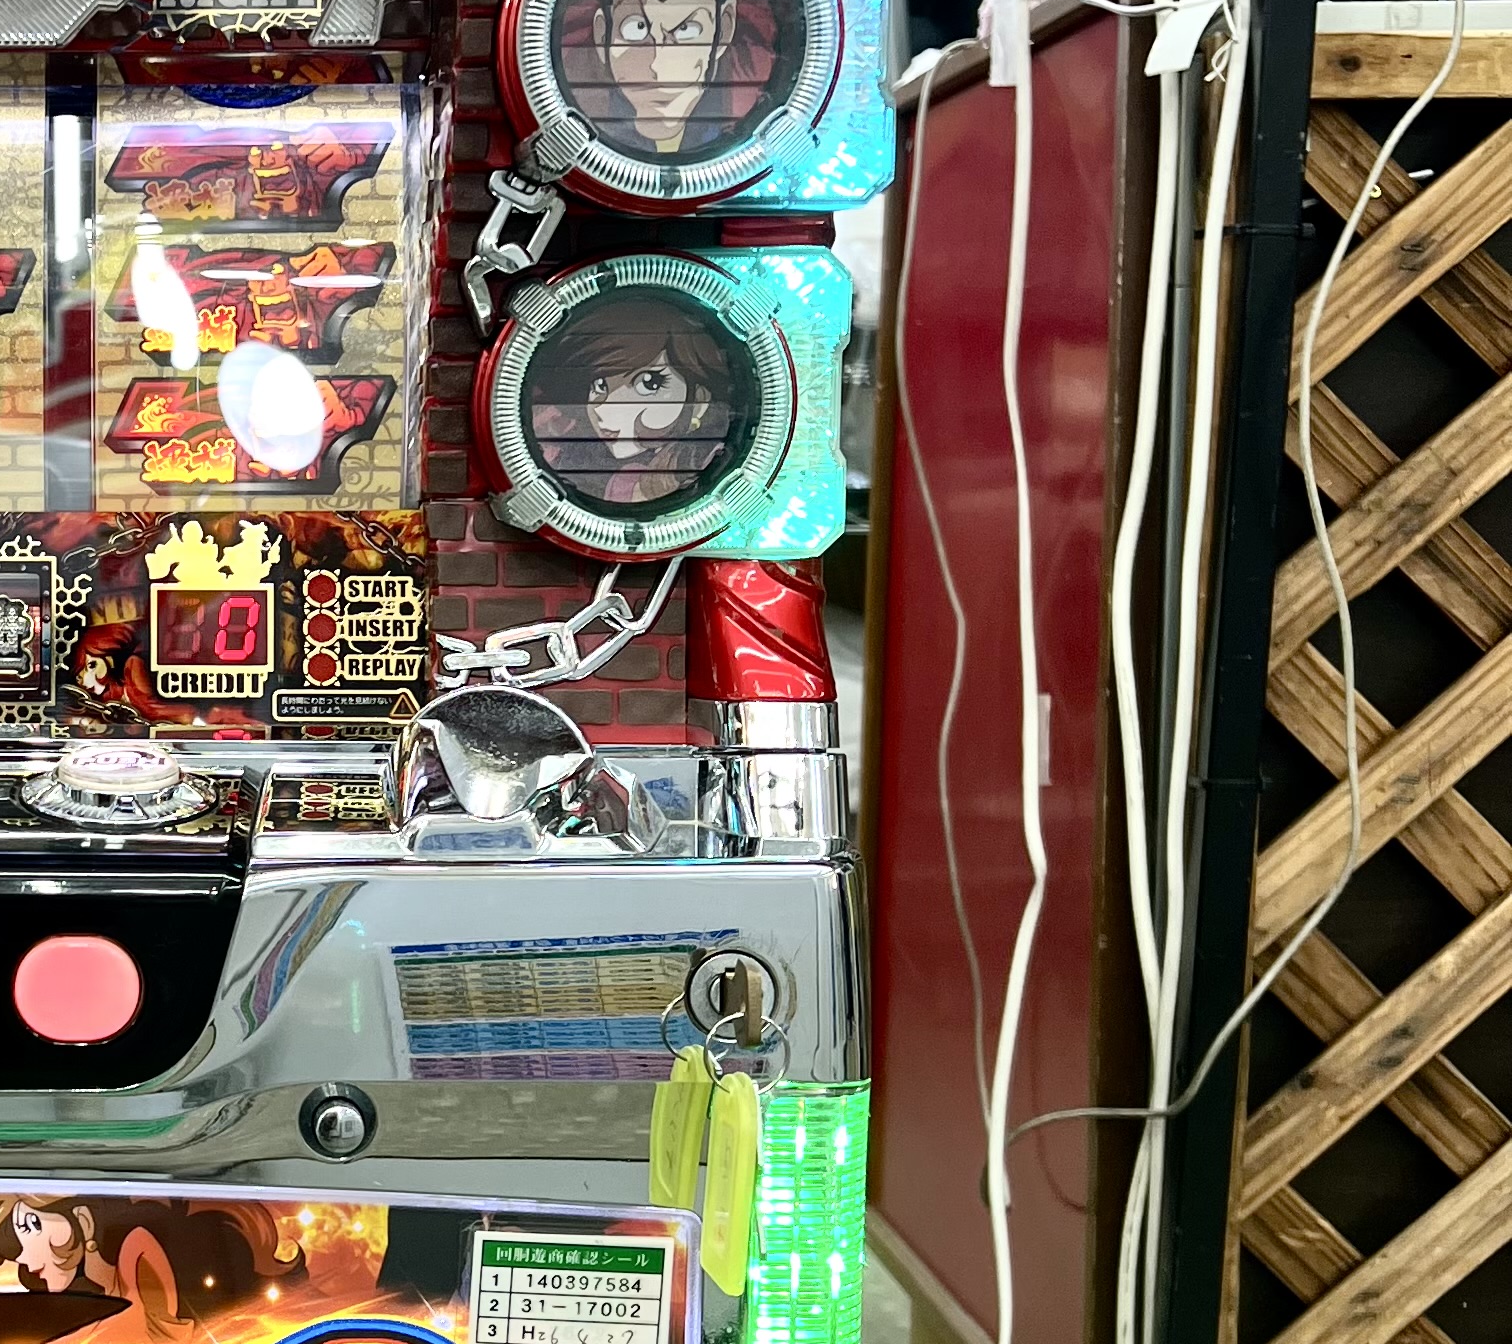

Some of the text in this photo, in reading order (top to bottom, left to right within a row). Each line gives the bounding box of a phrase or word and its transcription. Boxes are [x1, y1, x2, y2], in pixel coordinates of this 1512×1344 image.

[347, 579, 410, 599] START
[347, 618, 418, 638] INSERT
[347, 657, 420, 678] REPLAY
[159, 671, 265, 695] CREDIT
[495, 1246, 650, 1268] 回胴遊商確認シール
[526, 1273, 642, 1293] 140397584
